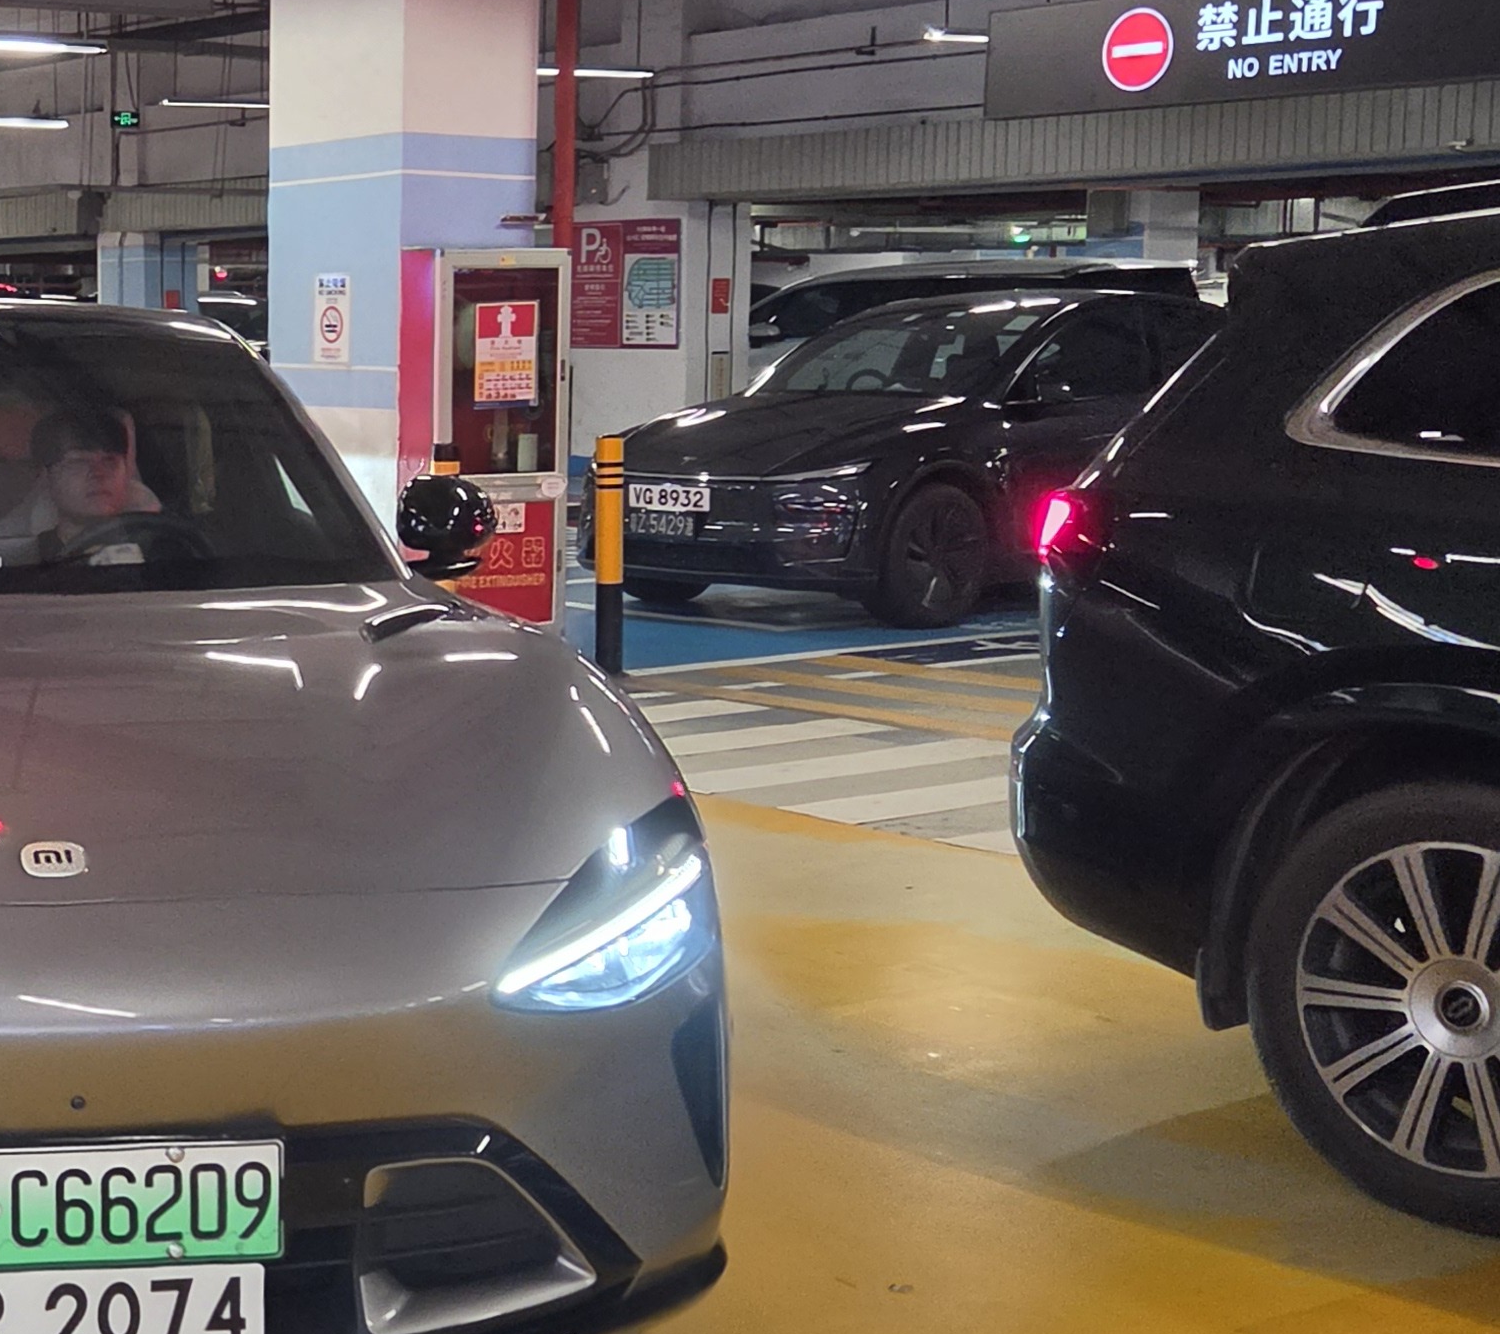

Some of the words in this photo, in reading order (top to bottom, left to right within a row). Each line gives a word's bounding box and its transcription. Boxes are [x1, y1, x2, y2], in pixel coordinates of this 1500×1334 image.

[1227, 57, 1260, 80] NO
[1267, 48, 1343, 76] ENTRY
[633, 487, 653, 505] VG
[658, 489, 704, 508] 8932
[10, 1161, 272, 1248] C66209
